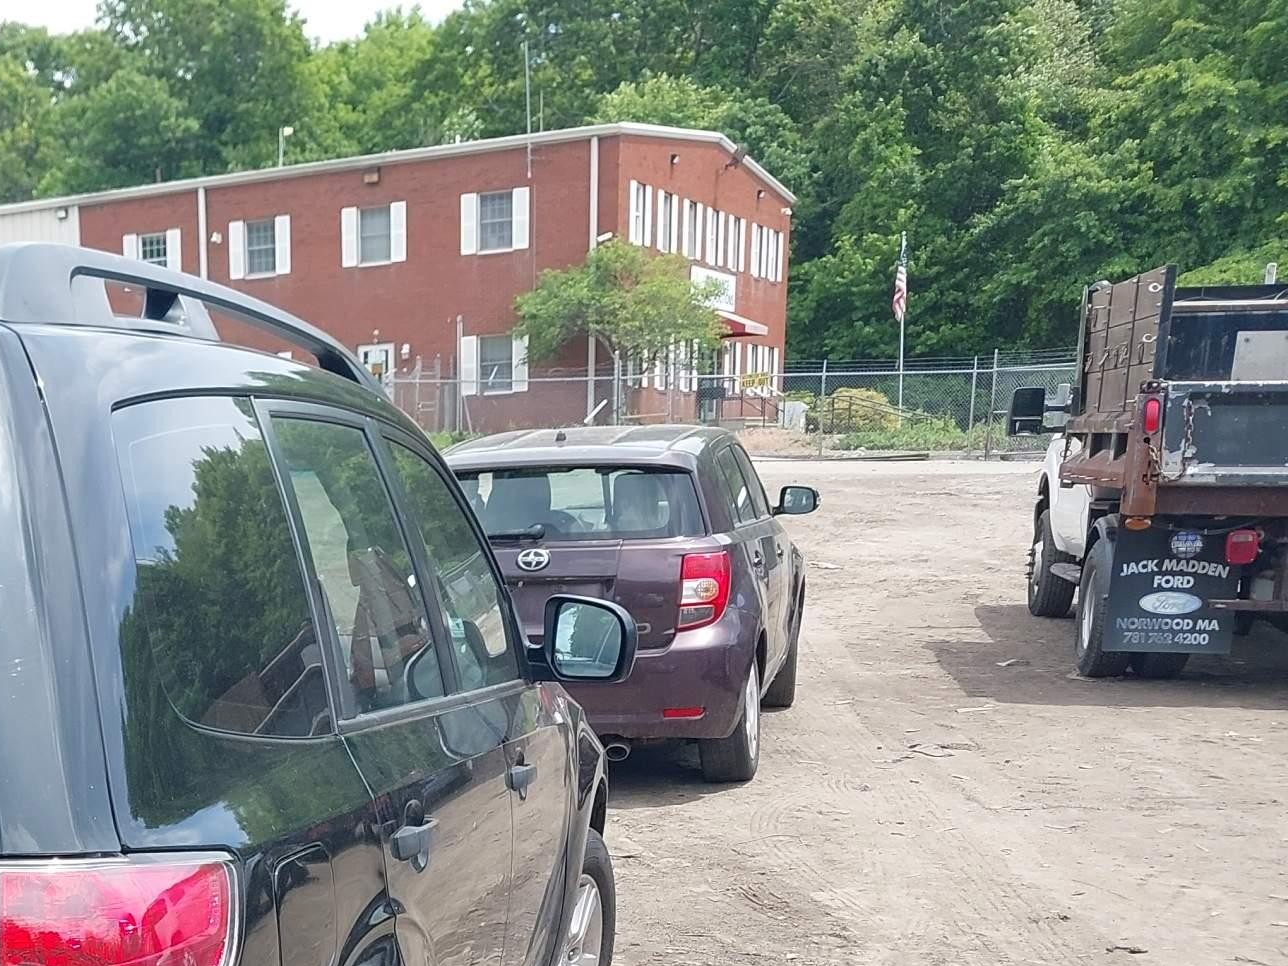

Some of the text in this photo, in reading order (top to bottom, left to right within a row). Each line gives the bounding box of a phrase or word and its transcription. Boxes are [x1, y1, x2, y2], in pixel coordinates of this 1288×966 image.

[1120, 559, 1230, 578] JACK MADDEN
[1153, 575, 1194, 588] FORD
[1116, 618, 1219, 631] NORWOOD MA
[1122, 631, 1145, 644] 781
[1174, 632, 1209, 645] 4200
